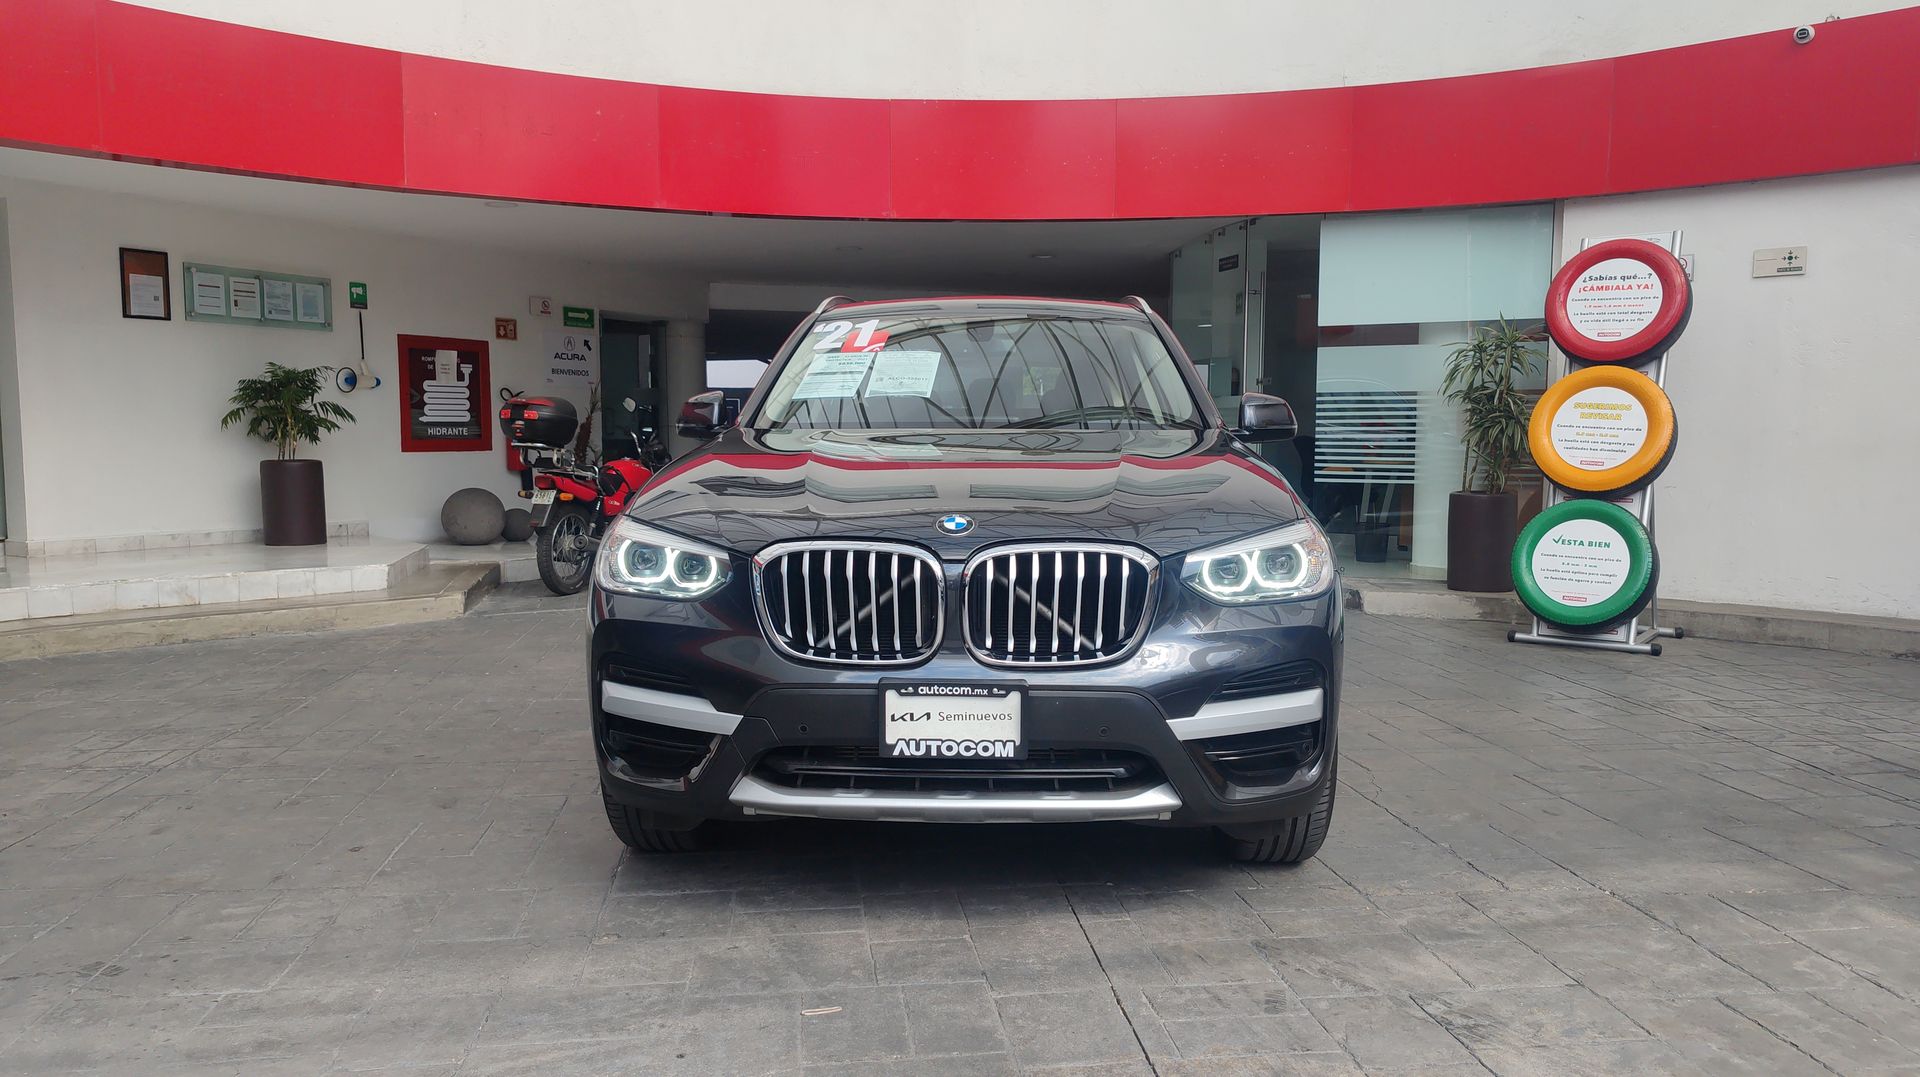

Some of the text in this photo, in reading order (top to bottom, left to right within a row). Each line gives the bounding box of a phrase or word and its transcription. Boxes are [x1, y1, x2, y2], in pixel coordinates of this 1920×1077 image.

[1583, 273, 1652, 283] ¿Sabías qué...?
[1579, 284, 1632, 293] ¡CÁMBIALA
[554, 352, 587, 361] ACURA
[552, 368, 589, 376] BIENVENIDOS
[1573, 402, 1632, 411] SUGERIMOS
[918, 685, 988, 695] autocom.mx
[938, 711, 1013, 722] Seminuevos
[892, 740, 1014, 758] AUTOCOM
